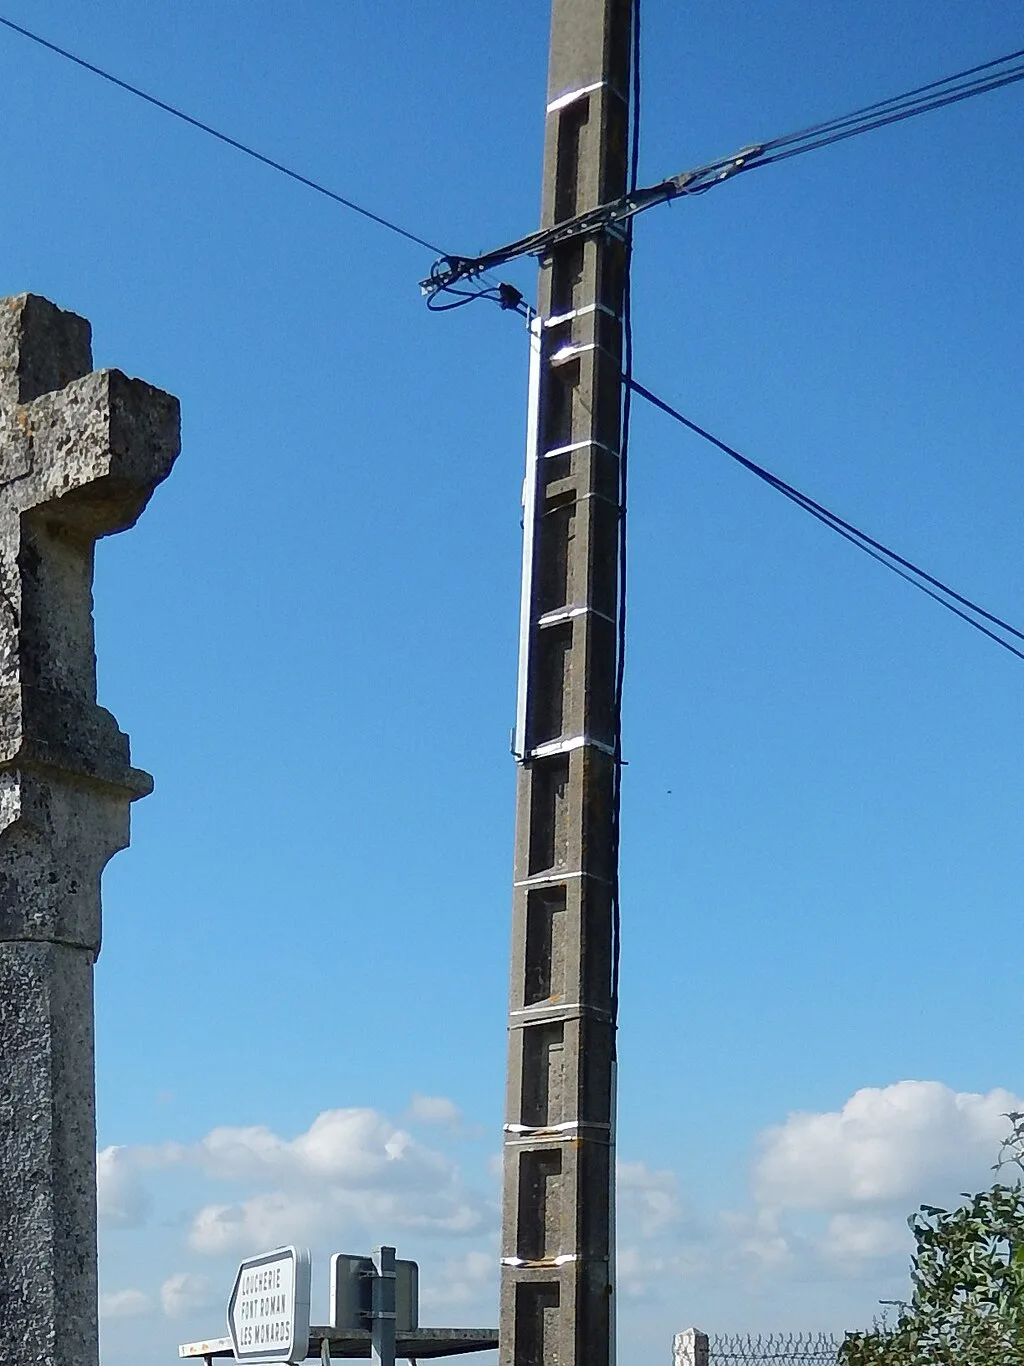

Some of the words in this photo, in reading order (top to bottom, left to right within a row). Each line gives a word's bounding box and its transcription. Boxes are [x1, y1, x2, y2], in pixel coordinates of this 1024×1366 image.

[242, 1268, 281, 1296] LOUCHERIE
[260, 1294, 286, 1317] ROMAN
[240, 1326, 252, 1346] LES
[254, 1321, 290, 1344] MONARDS
